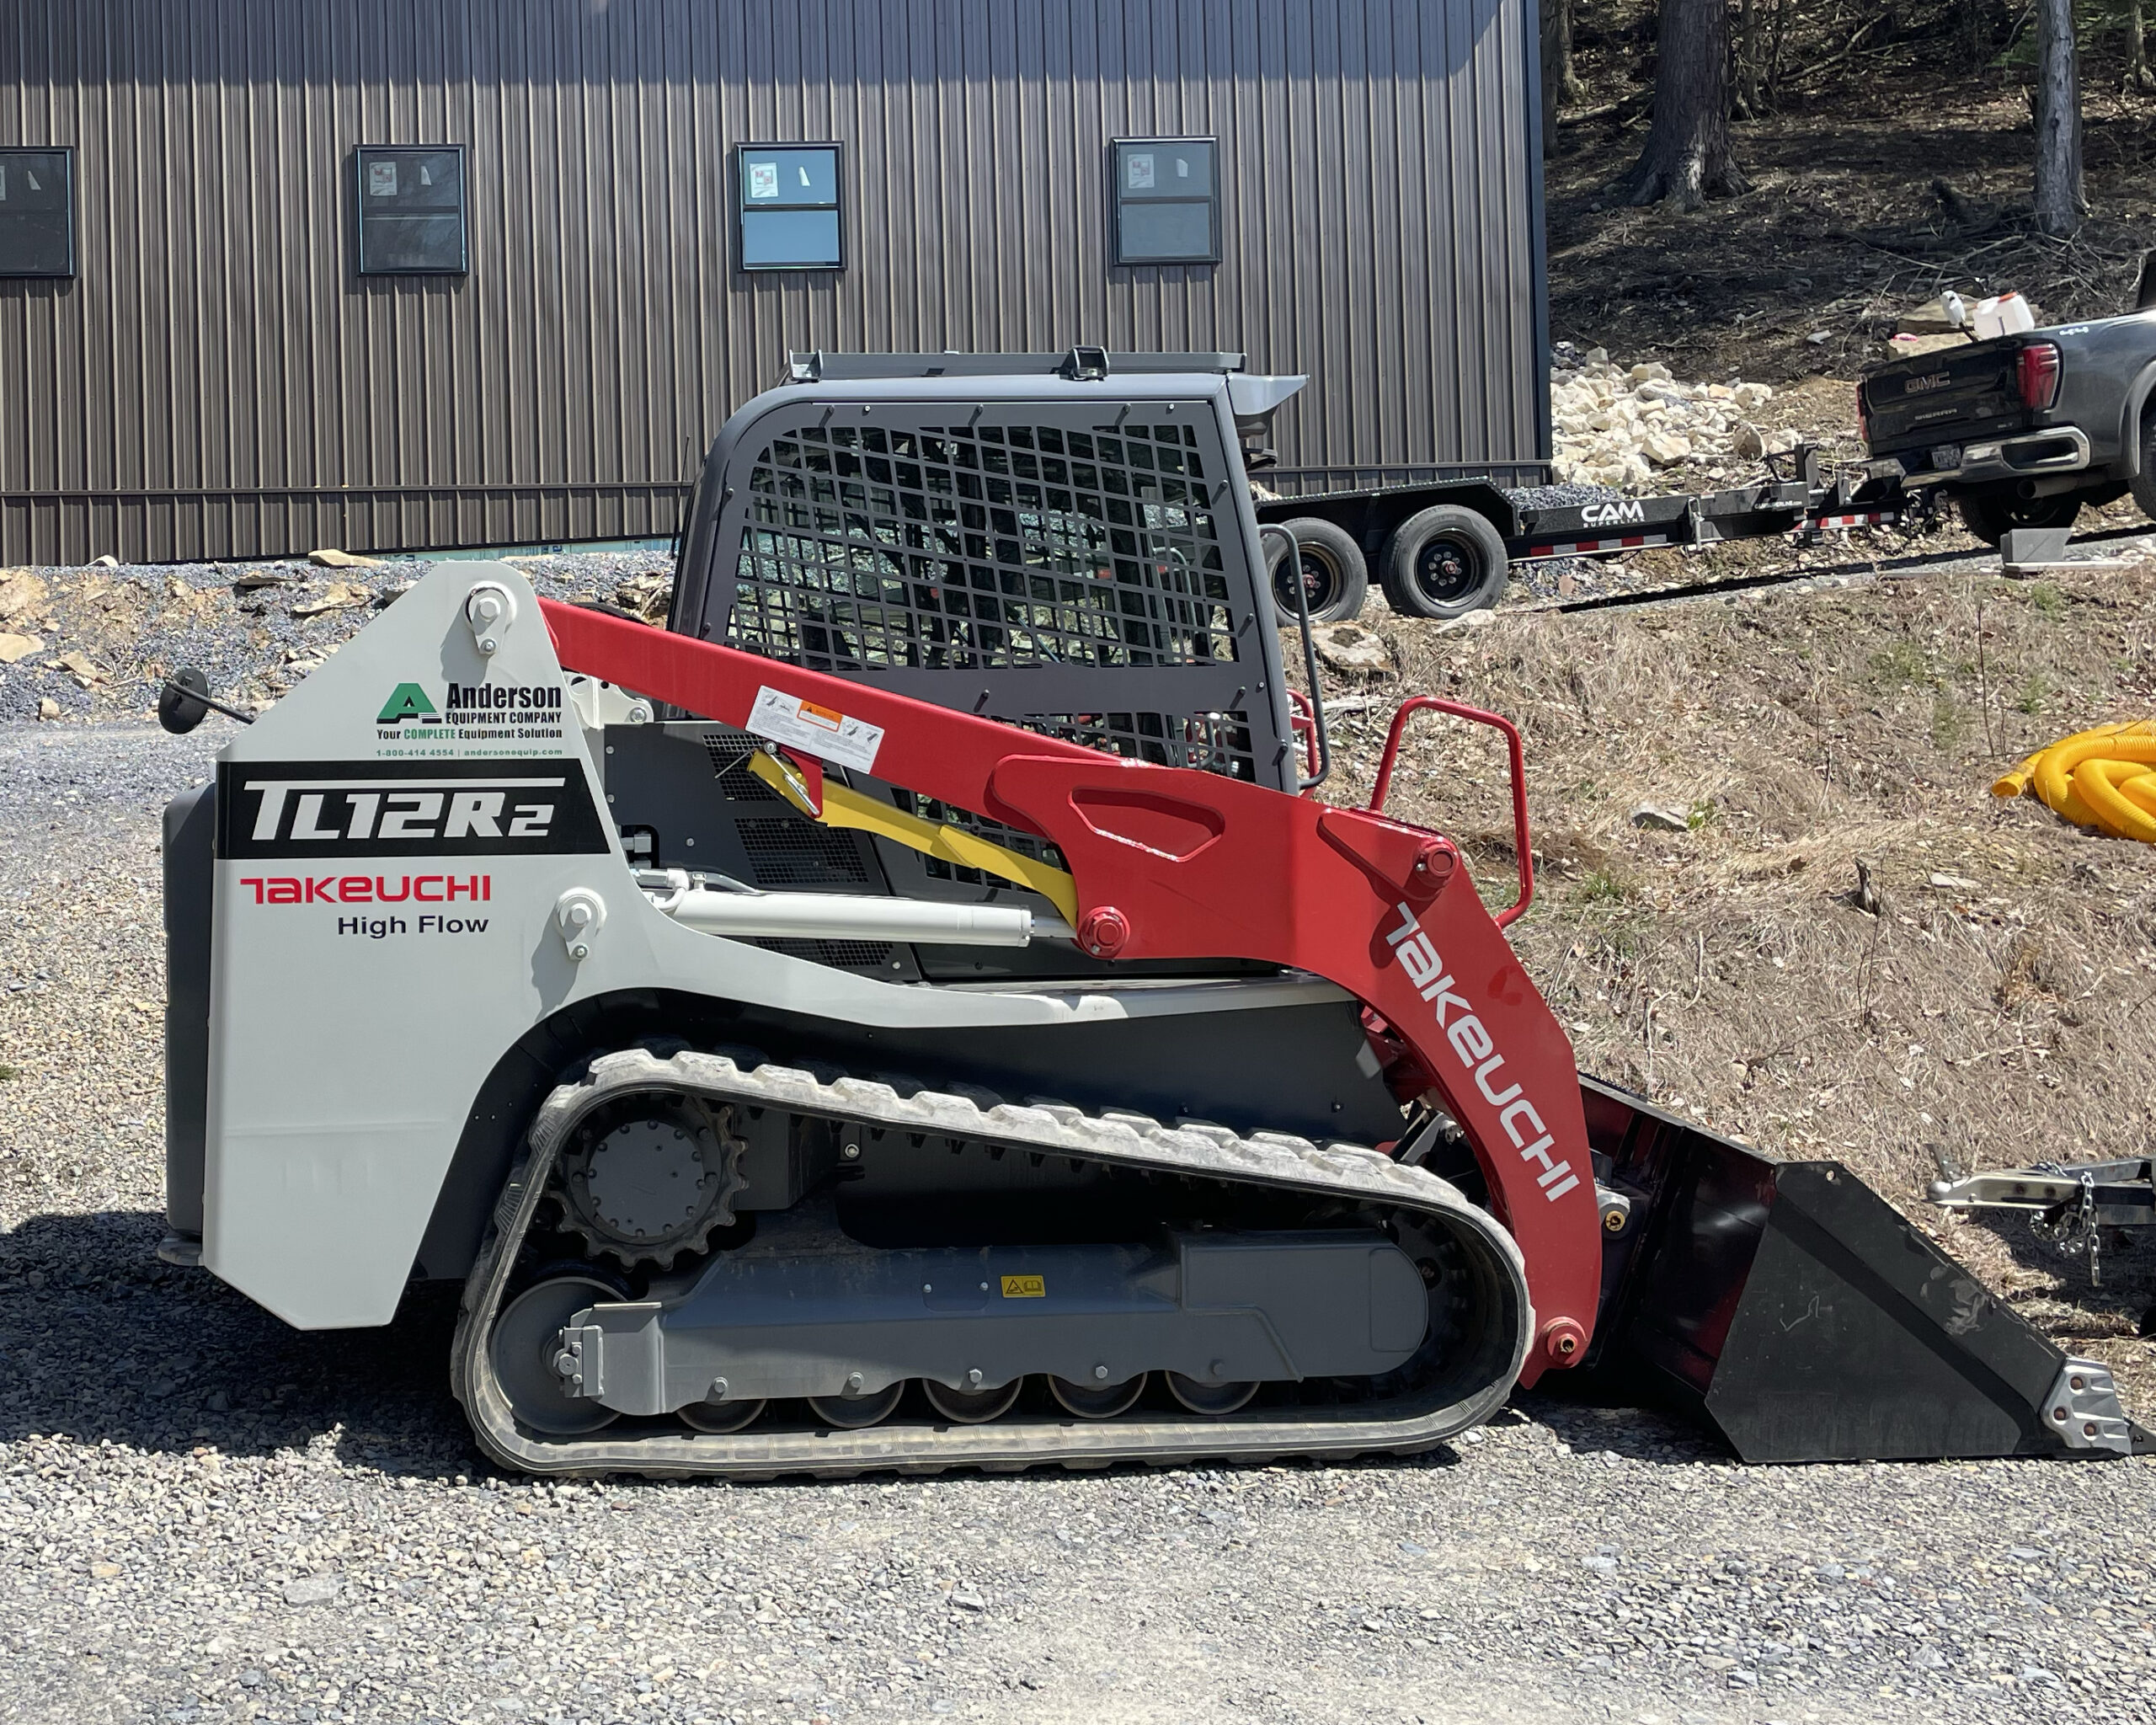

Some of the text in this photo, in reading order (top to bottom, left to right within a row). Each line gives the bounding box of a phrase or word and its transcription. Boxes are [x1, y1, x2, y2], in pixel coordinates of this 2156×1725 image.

[1905, 371, 1951, 393] GMC
[1581, 500, 1645, 522] CAM
[1583, 517, 1646, 528] SUPERLINE
[446, 682, 562, 709] Anderson
[446, 712, 562, 725] EQUIPMENT COMPANY
[376, 728, 563, 740] Your COMPLETE Equipment Solution
[464, 748, 563, 757] andersonequip.com
[338, 915, 489, 939] High Flow
